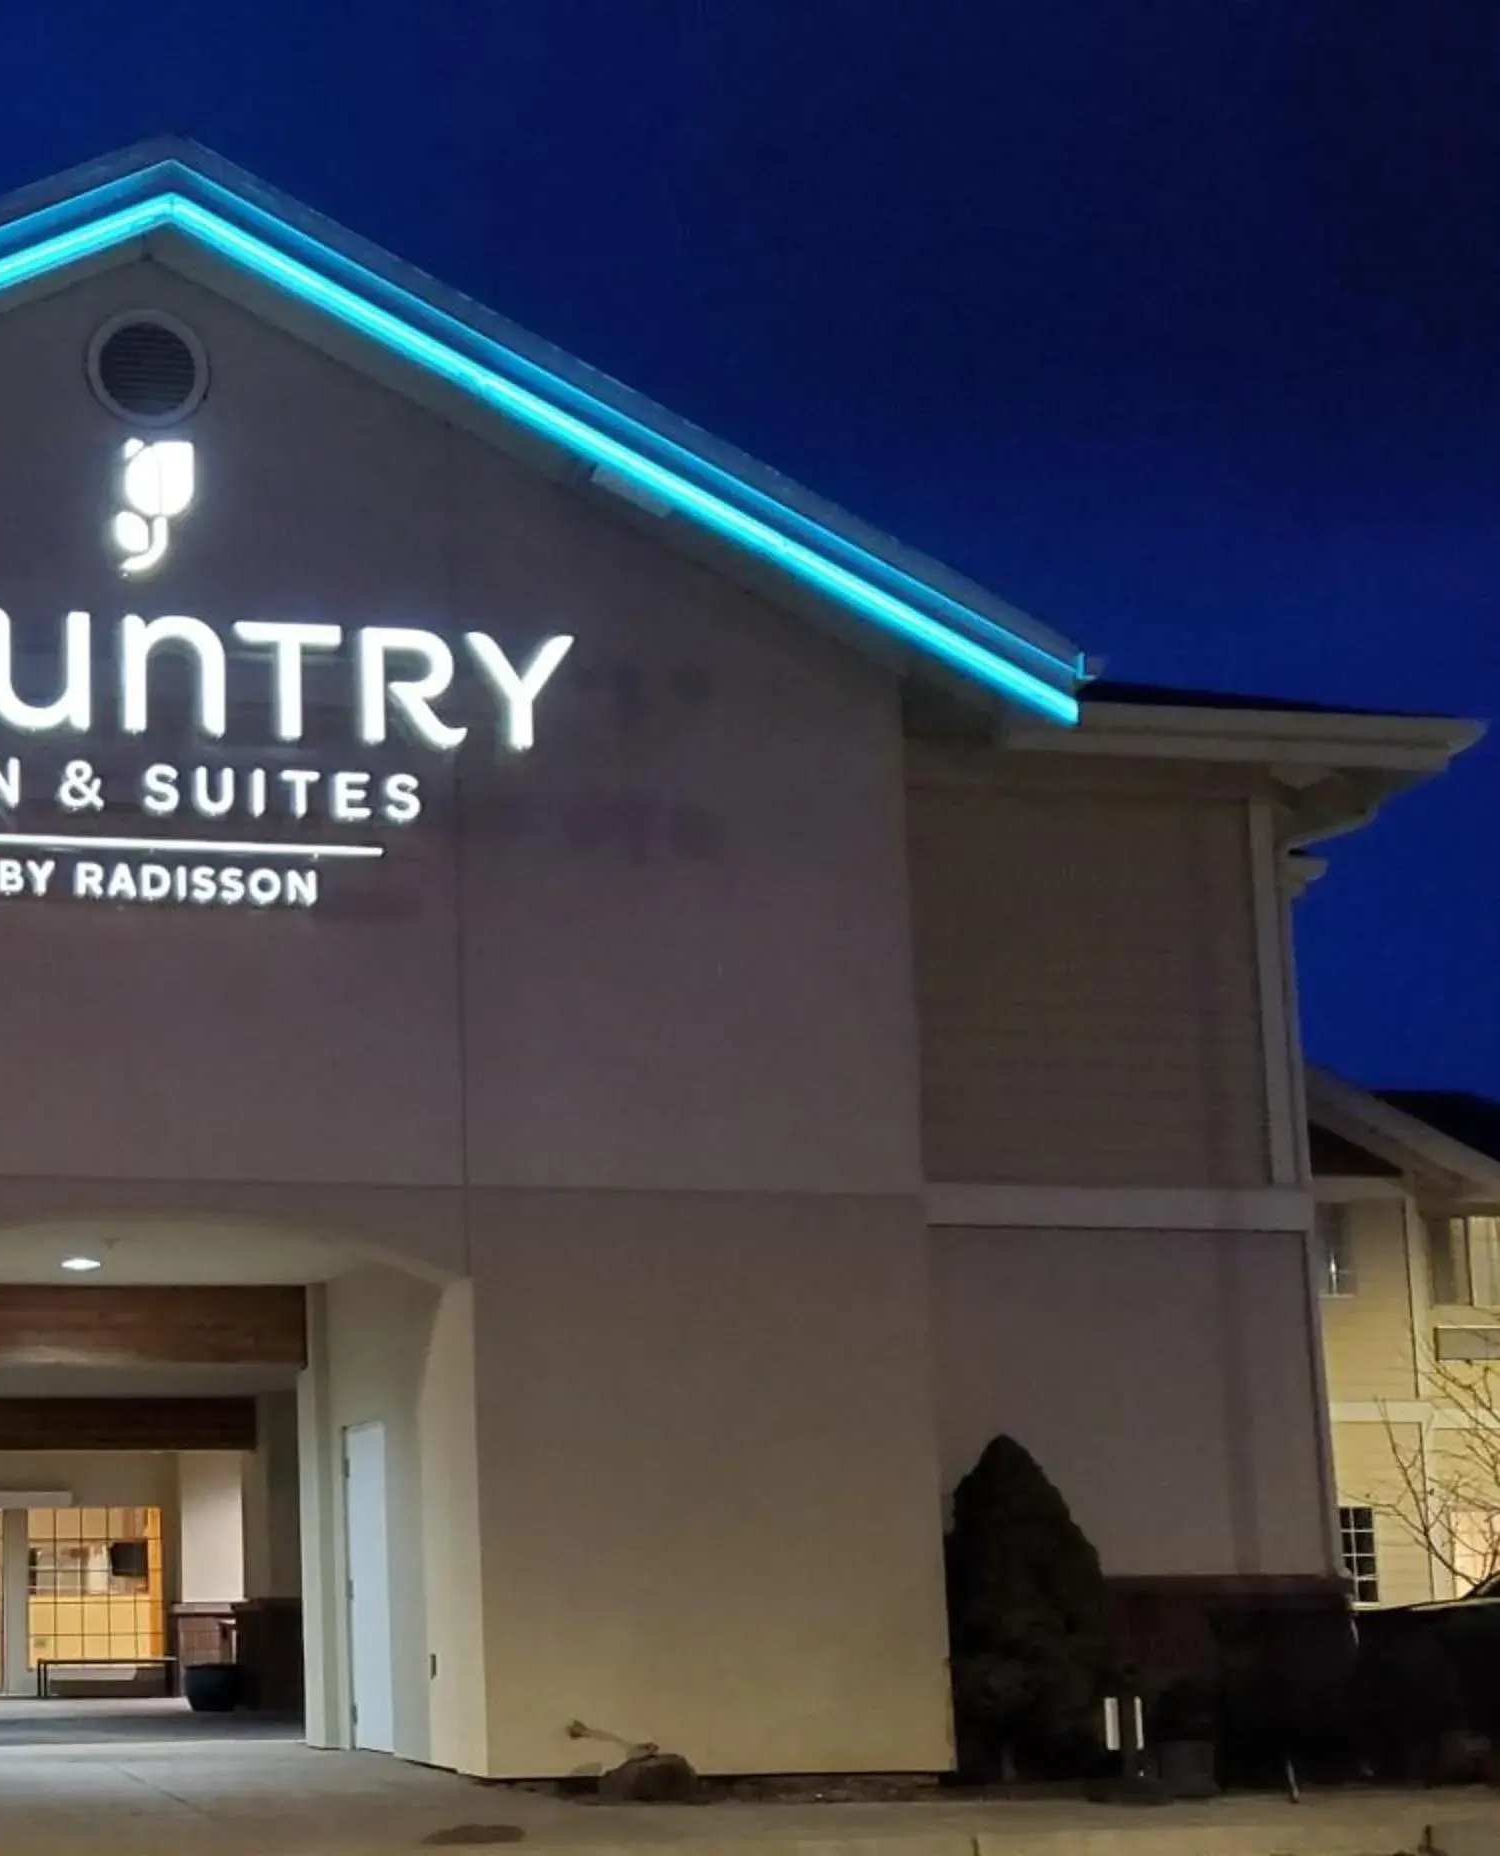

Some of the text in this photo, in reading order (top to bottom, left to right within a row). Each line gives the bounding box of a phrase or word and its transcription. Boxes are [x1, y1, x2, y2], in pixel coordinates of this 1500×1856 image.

[57, 758, 106, 811] &
[142, 763, 422, 824] SUITES
[73, 861, 319, 906] RADISSON
